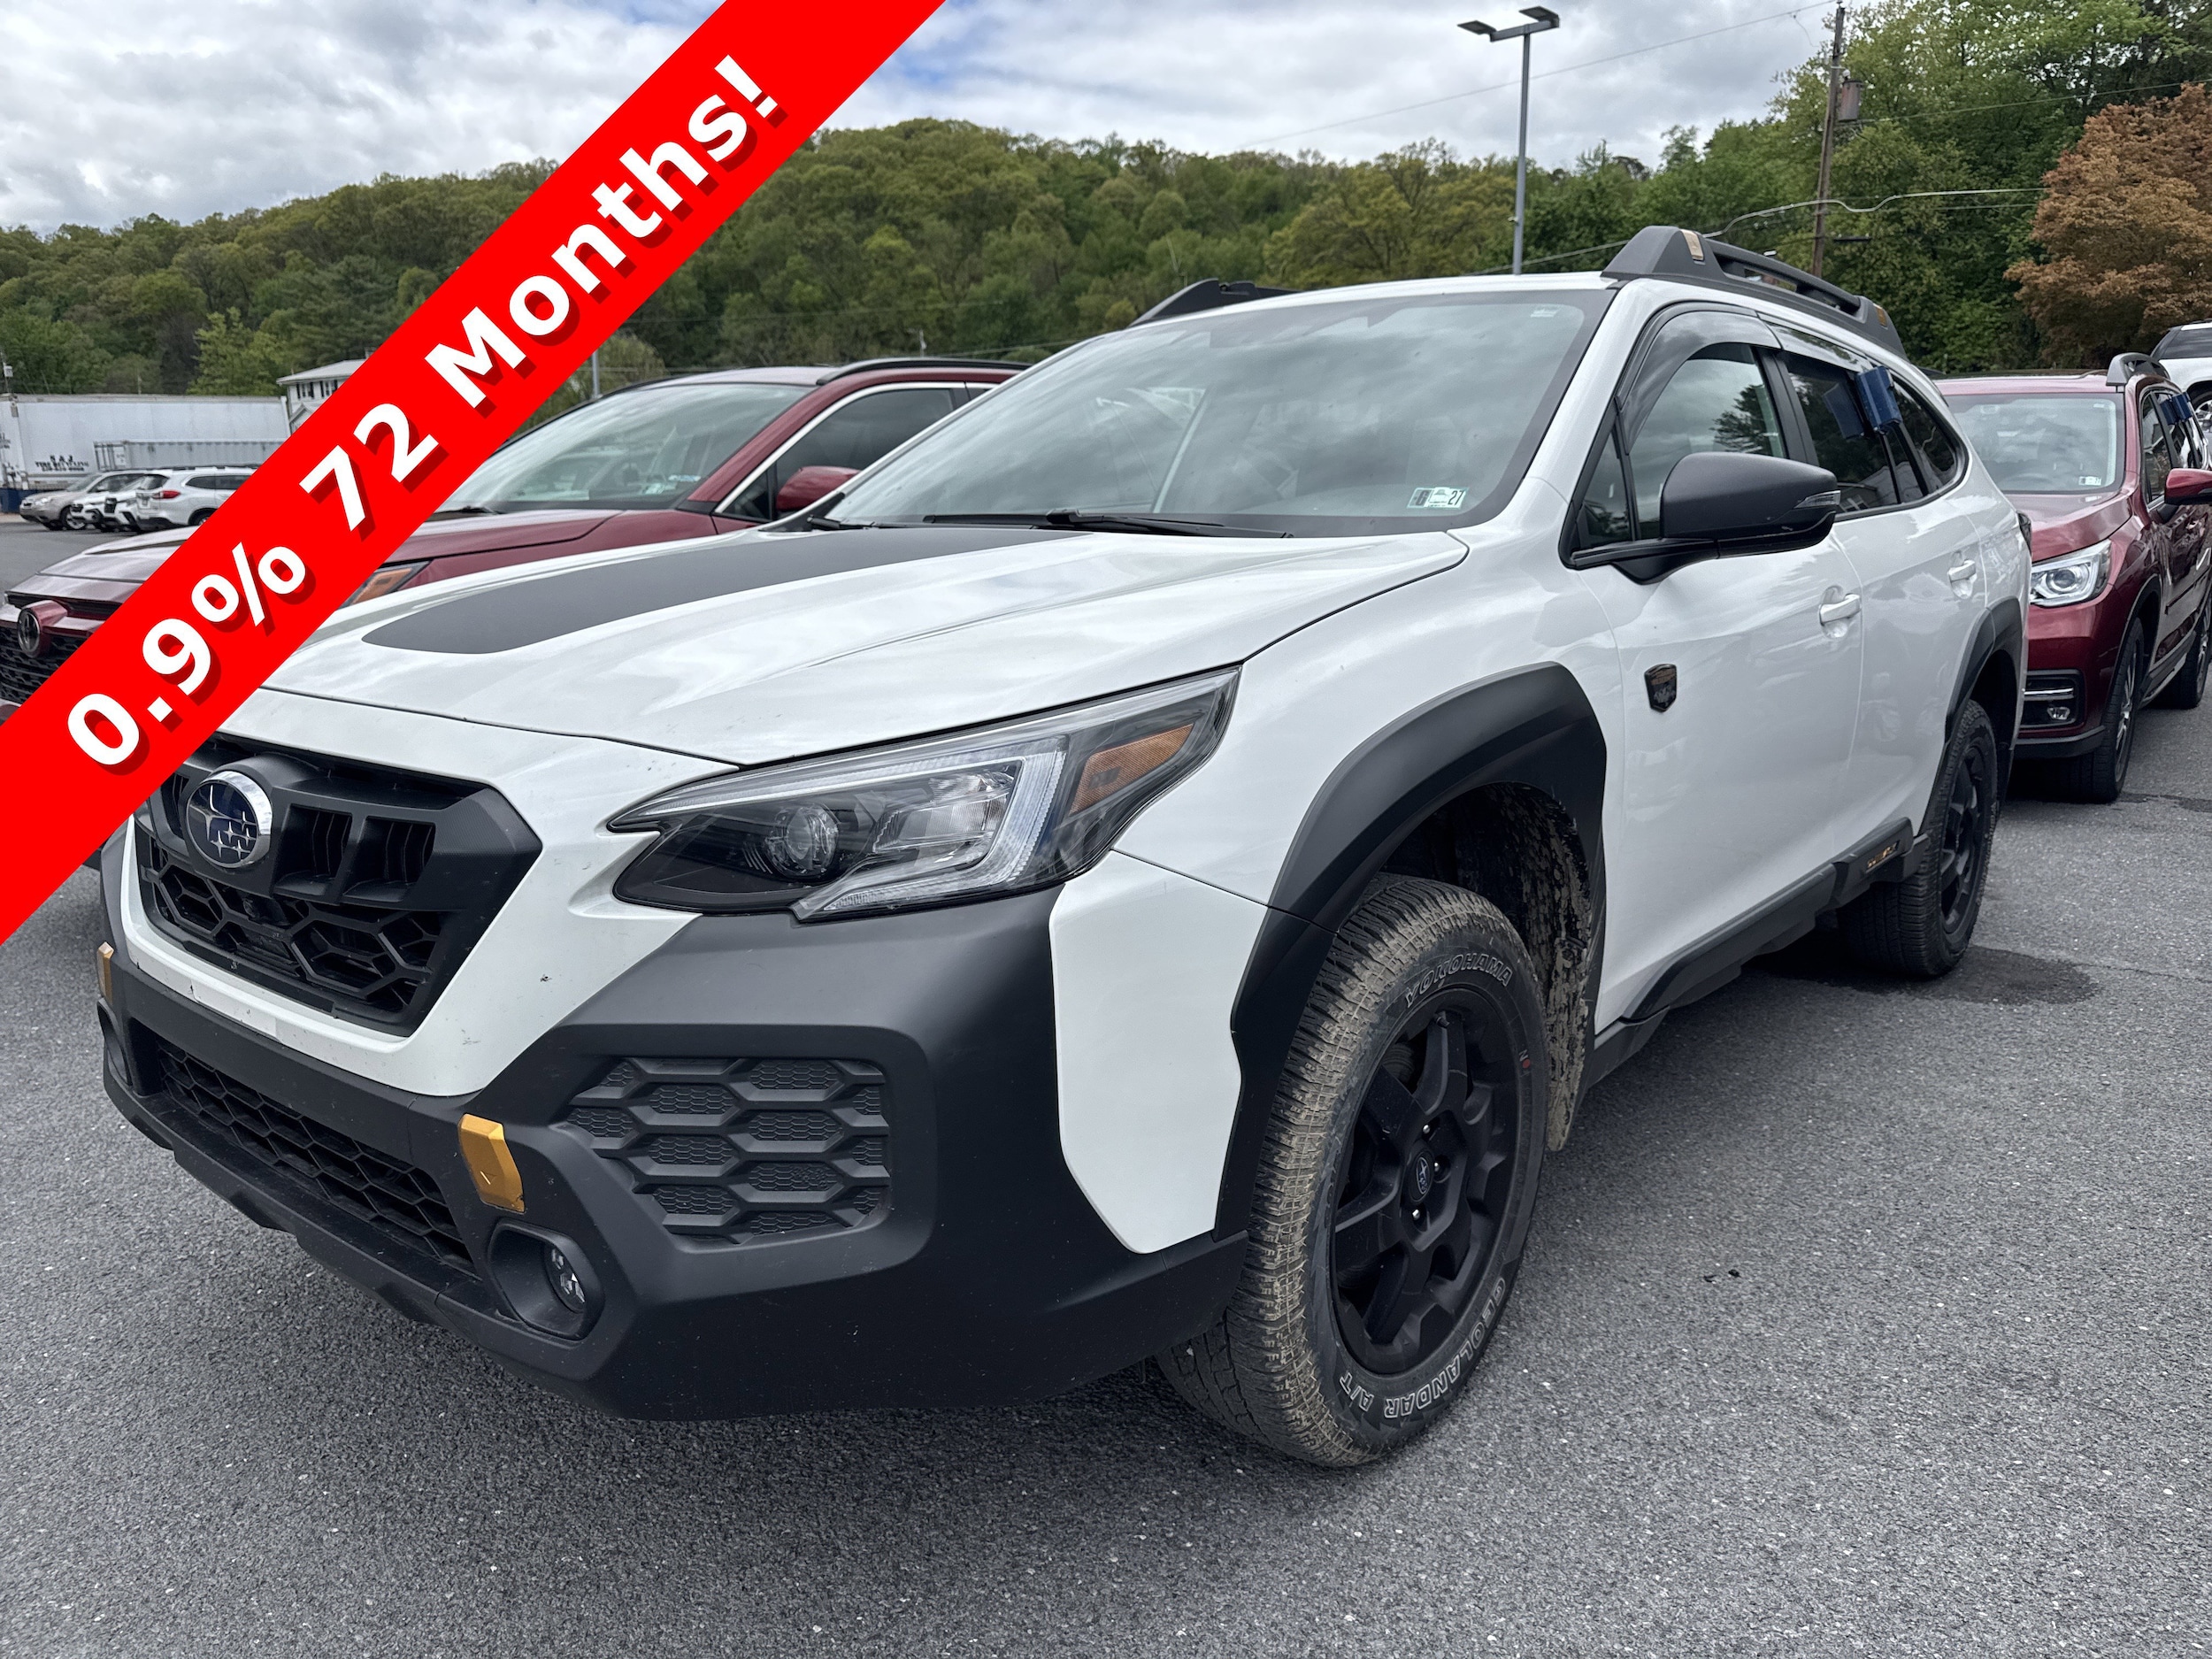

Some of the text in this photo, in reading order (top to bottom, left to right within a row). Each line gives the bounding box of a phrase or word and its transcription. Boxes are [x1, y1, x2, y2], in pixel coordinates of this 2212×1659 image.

[1448, 491, 1464, 505] 27
[1405, 953, 1513, 1008] YOKOHAMA
[1339, 1278, 1506, 1418] GEOLANDAR A/T
